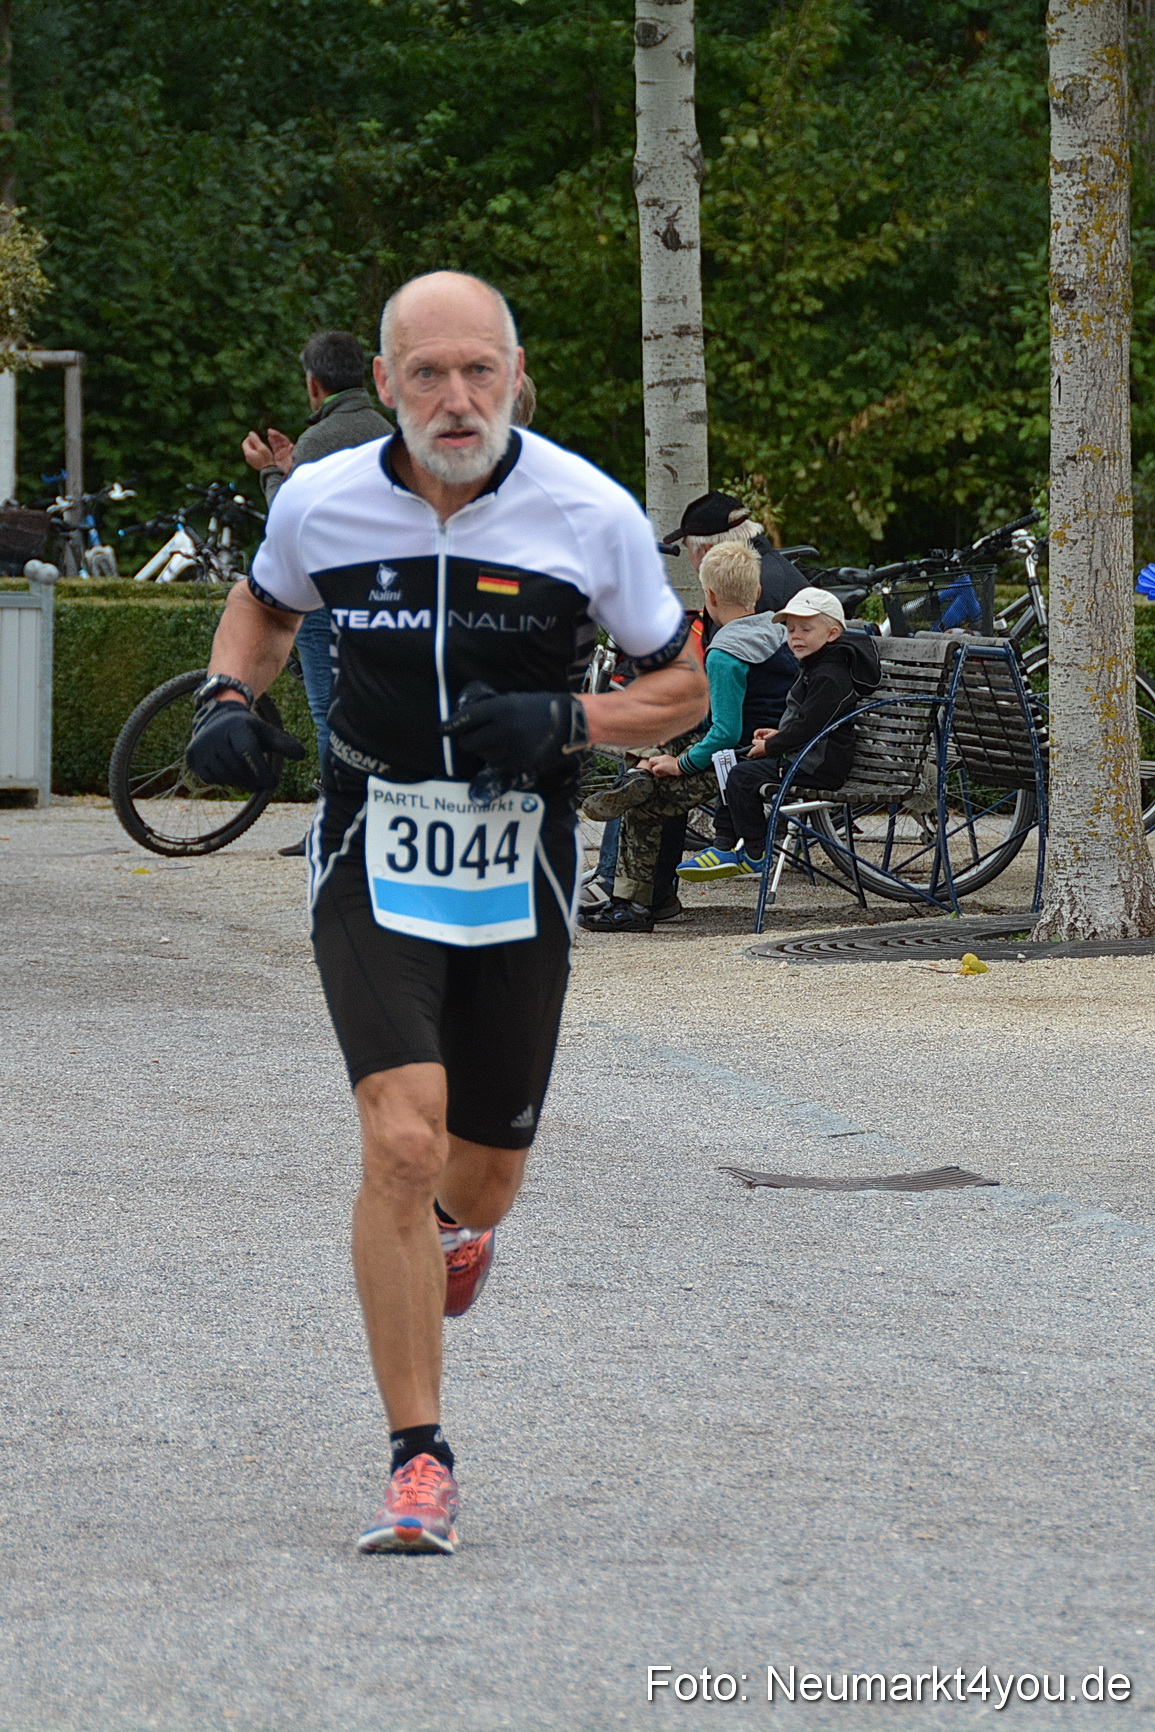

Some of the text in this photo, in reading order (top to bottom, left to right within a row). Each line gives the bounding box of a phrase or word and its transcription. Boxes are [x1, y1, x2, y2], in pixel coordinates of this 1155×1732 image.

[368, 589, 402, 601] Nalini
[332, 608, 431, 629] TEAM
[373, 789, 430, 809] PARTL
[385, 815, 521, 880] 3044
